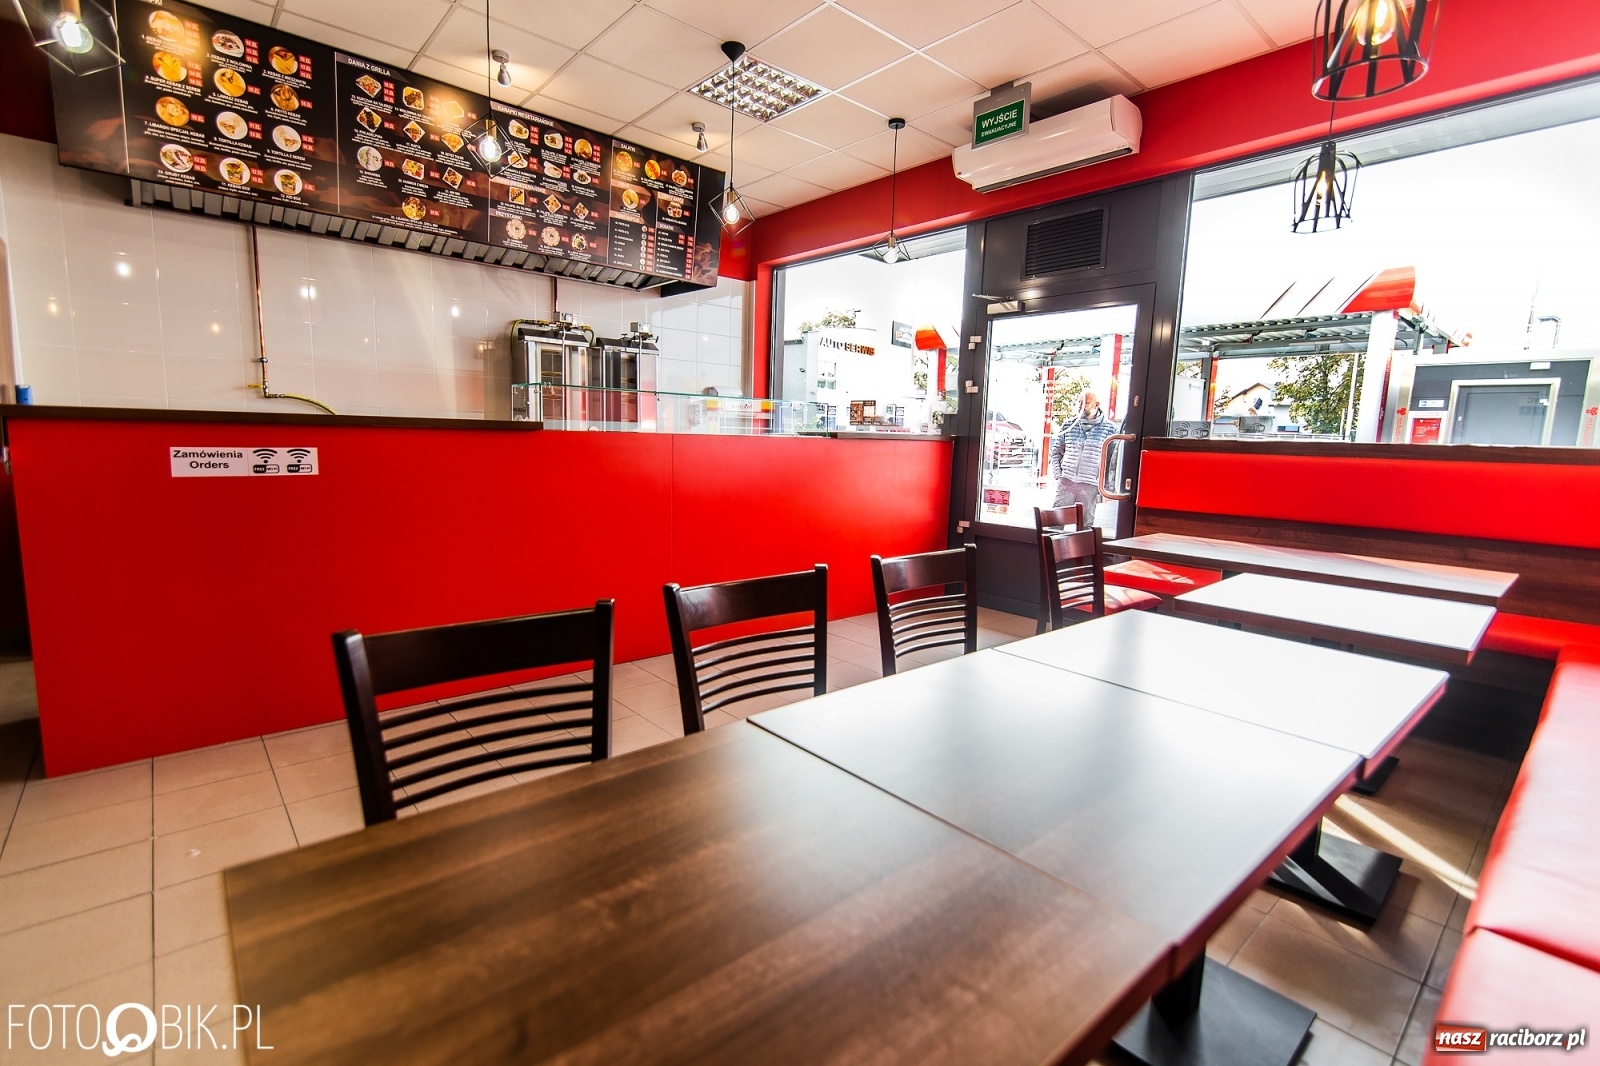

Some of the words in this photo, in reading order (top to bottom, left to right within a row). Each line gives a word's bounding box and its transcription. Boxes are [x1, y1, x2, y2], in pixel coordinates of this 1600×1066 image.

[348, 58, 366, 69] DANIA
[370, 66, 391, 76] GRILLA
[981, 109, 1018, 128] WYJŚCIE
[981, 121, 1016, 137] EWAKUACYJNE
[820, 337, 843, 350] AUTO
[173, 450, 243, 458] Zamówienia
